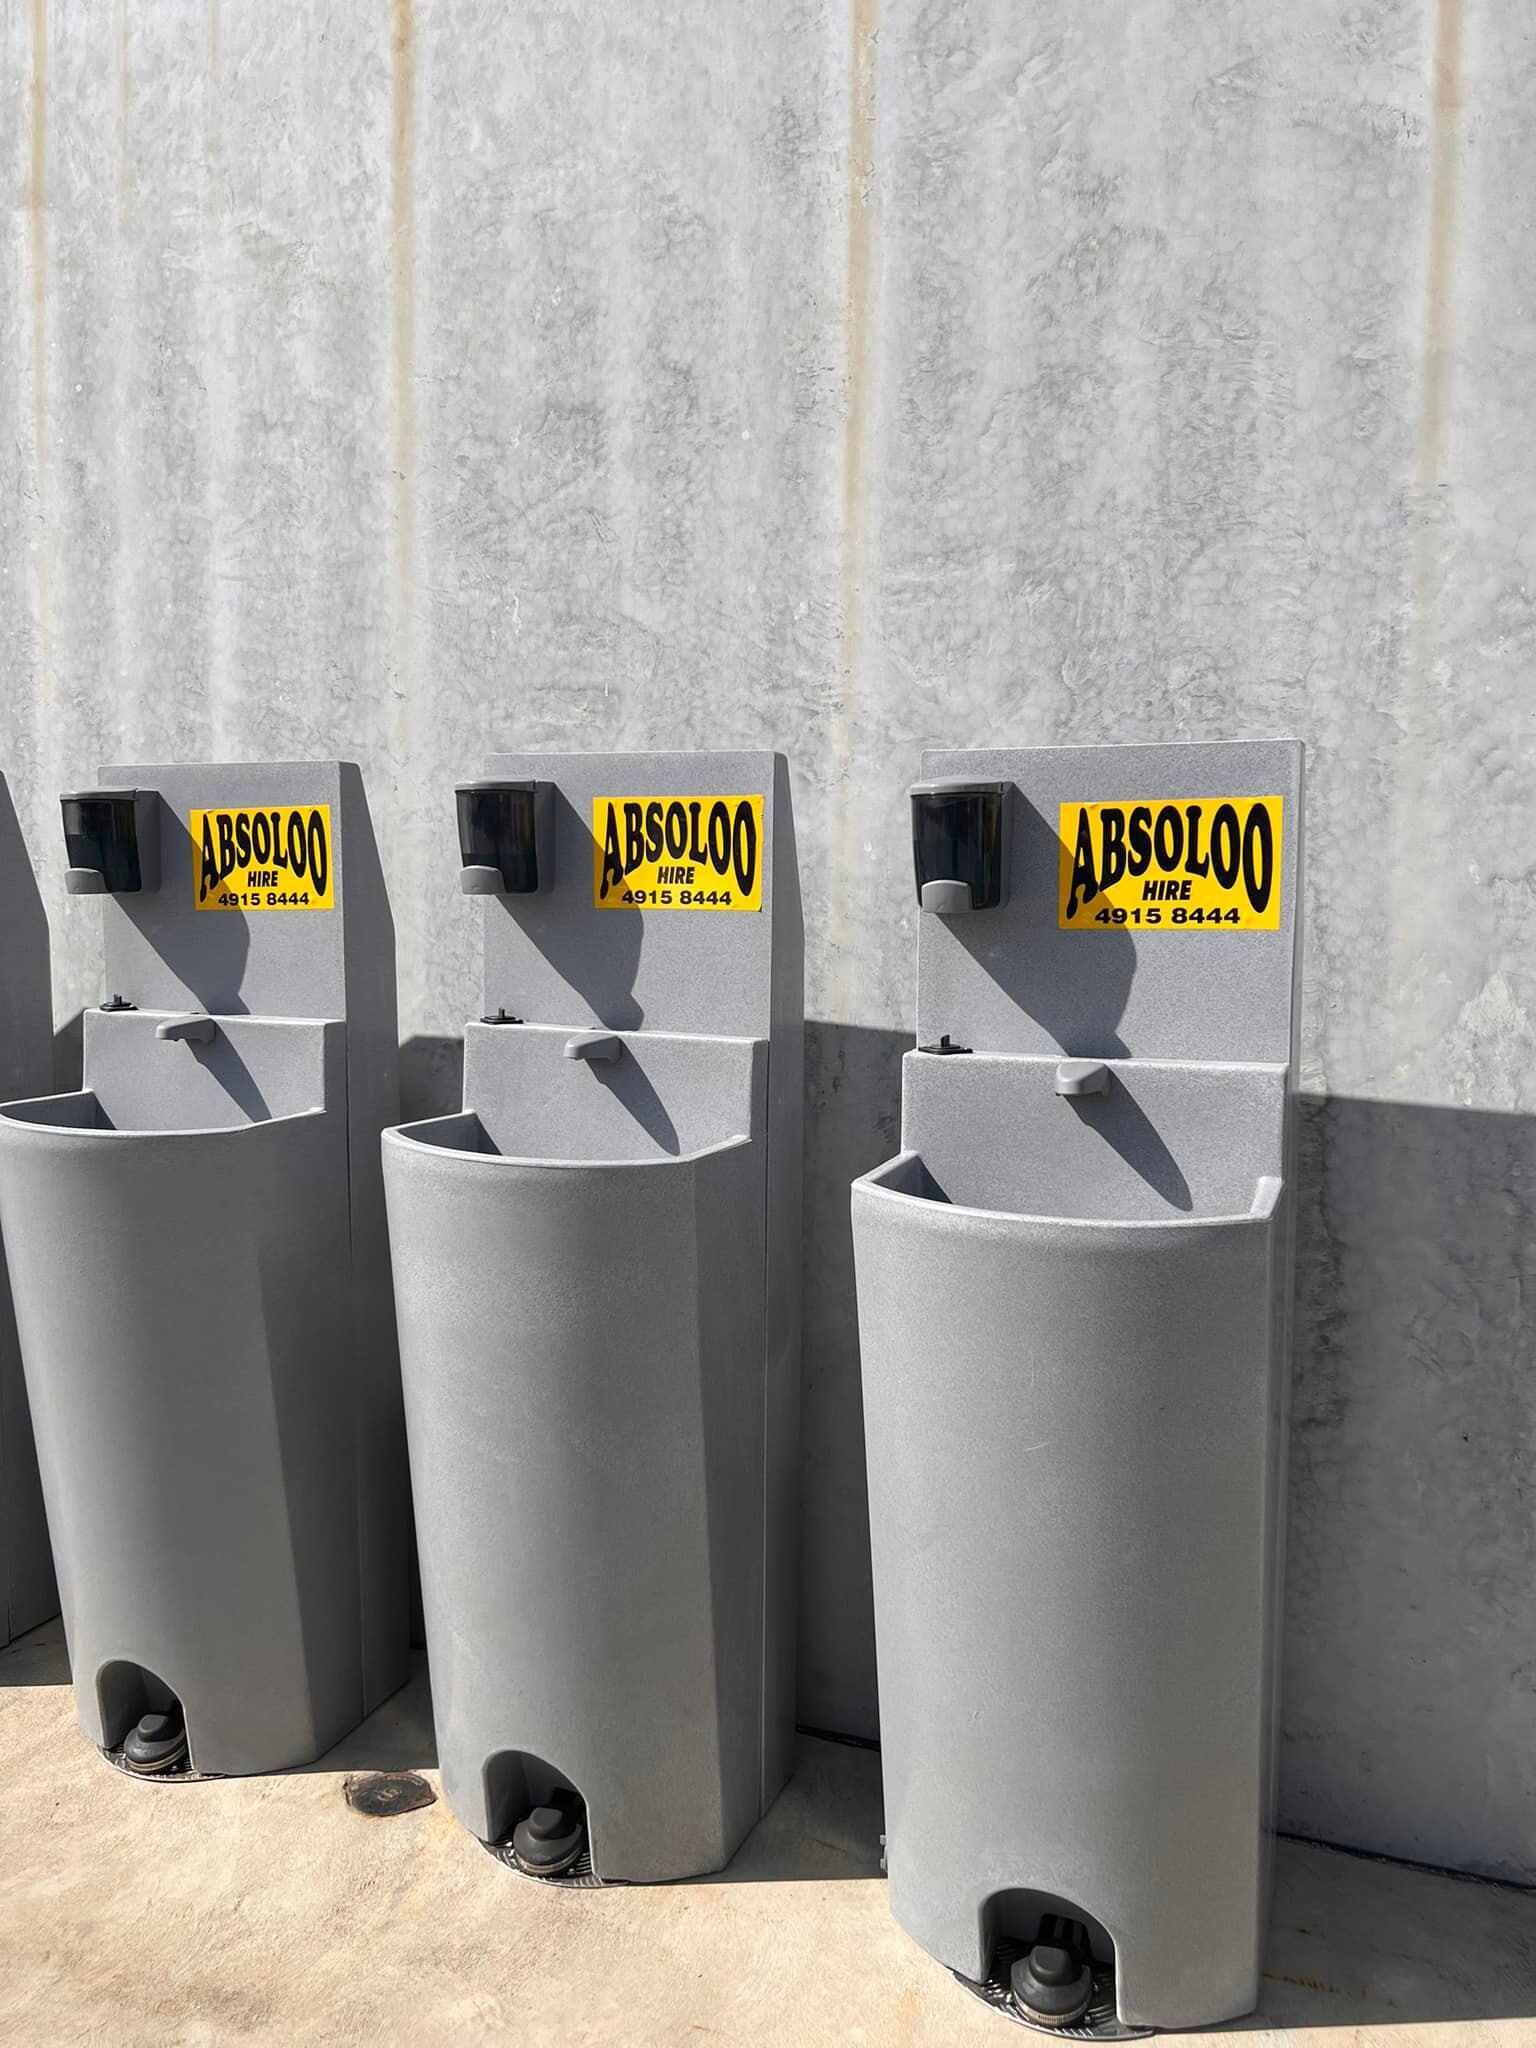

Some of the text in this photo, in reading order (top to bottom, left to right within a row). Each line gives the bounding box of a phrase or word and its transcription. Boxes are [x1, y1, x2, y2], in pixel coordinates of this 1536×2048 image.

[200, 810, 327, 903] ABSOLOO
[600, 801, 757, 900] ABSOLOO
[1066, 803, 1273, 920] ABSOLOO
[247, 871, 279, 888] HIRE
[657, 866, 696, 885] HIRE
[218, 892, 310, 906] 4915 8444
[622, 890, 732, 905] 4915 8444
[1142, 880, 1193, 901] HIRE
[1095, 908, 1241, 924] 4915 8444
